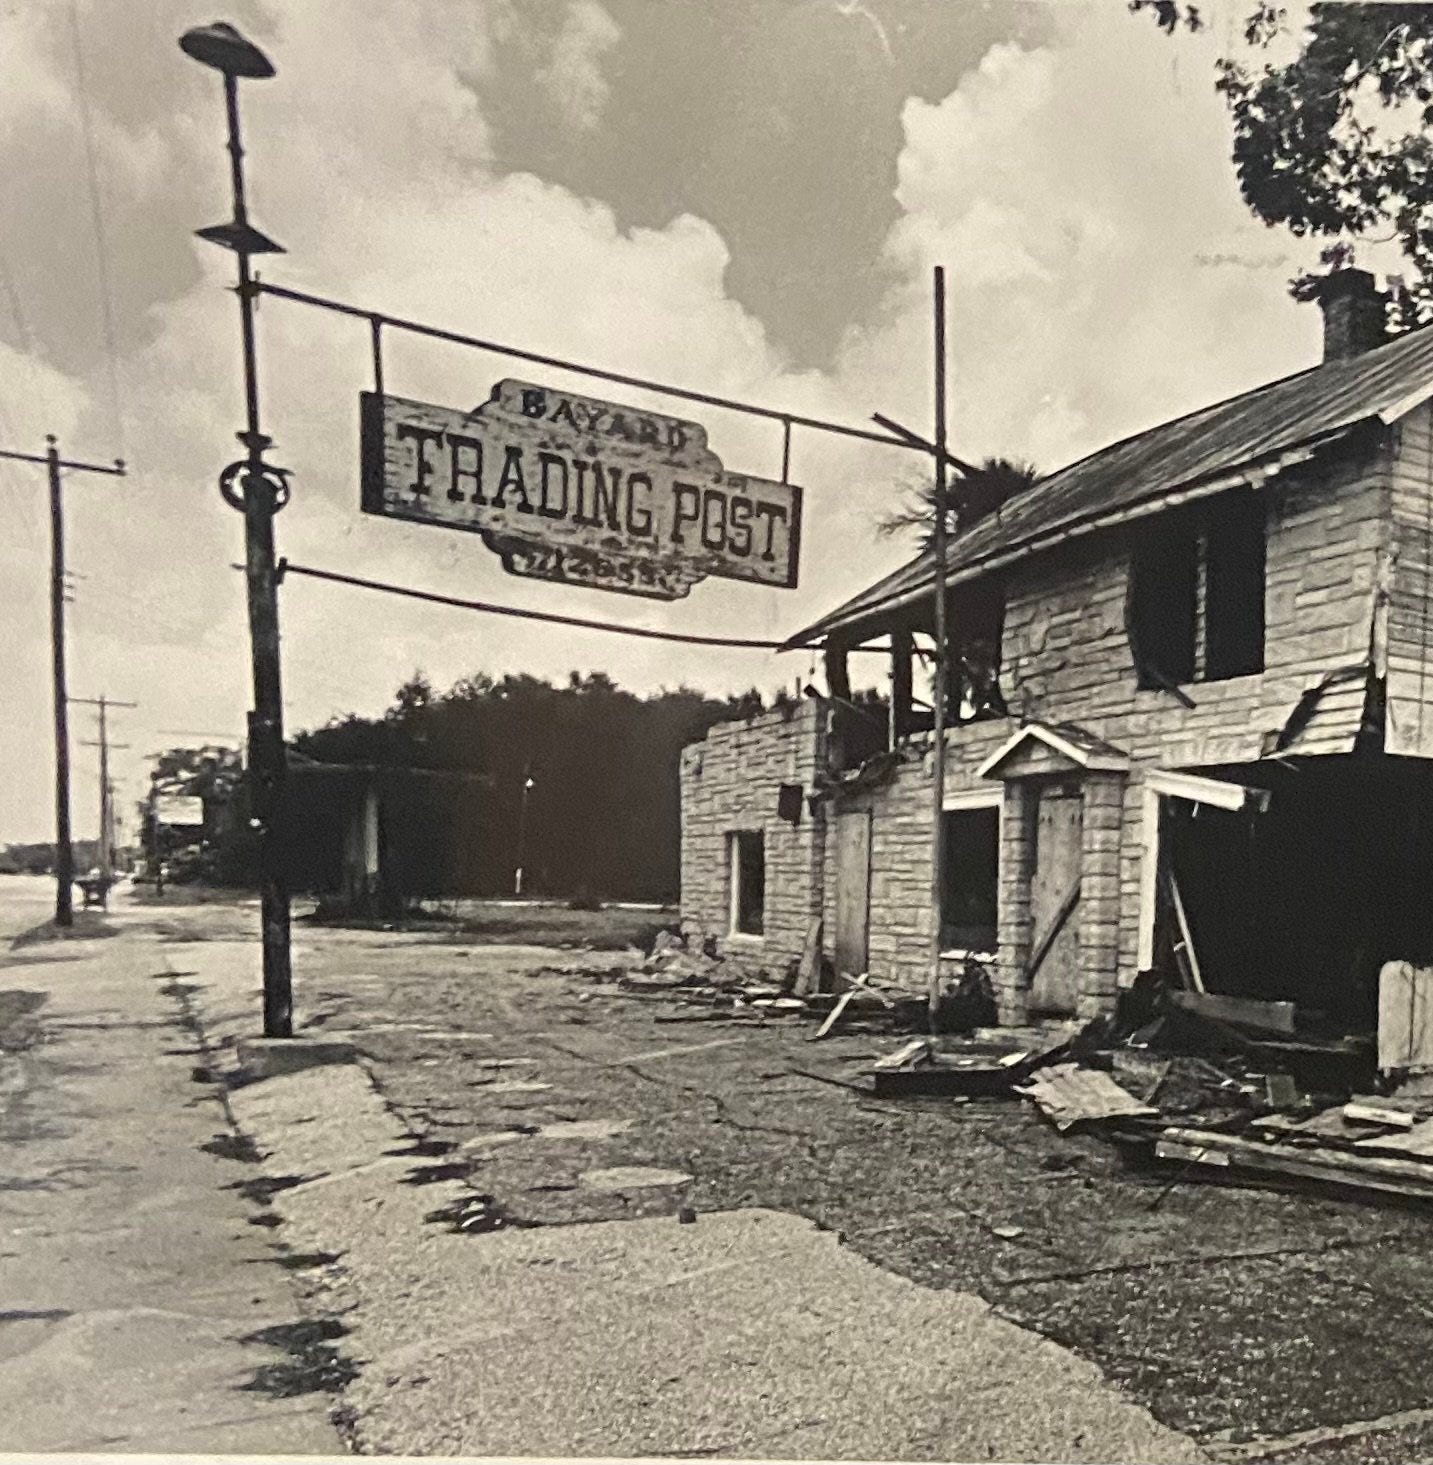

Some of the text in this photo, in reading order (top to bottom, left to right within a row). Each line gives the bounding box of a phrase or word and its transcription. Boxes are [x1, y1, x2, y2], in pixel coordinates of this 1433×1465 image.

[522, 389, 688, 451] BAYARD
[396, 423, 788, 562] TRADING POST
